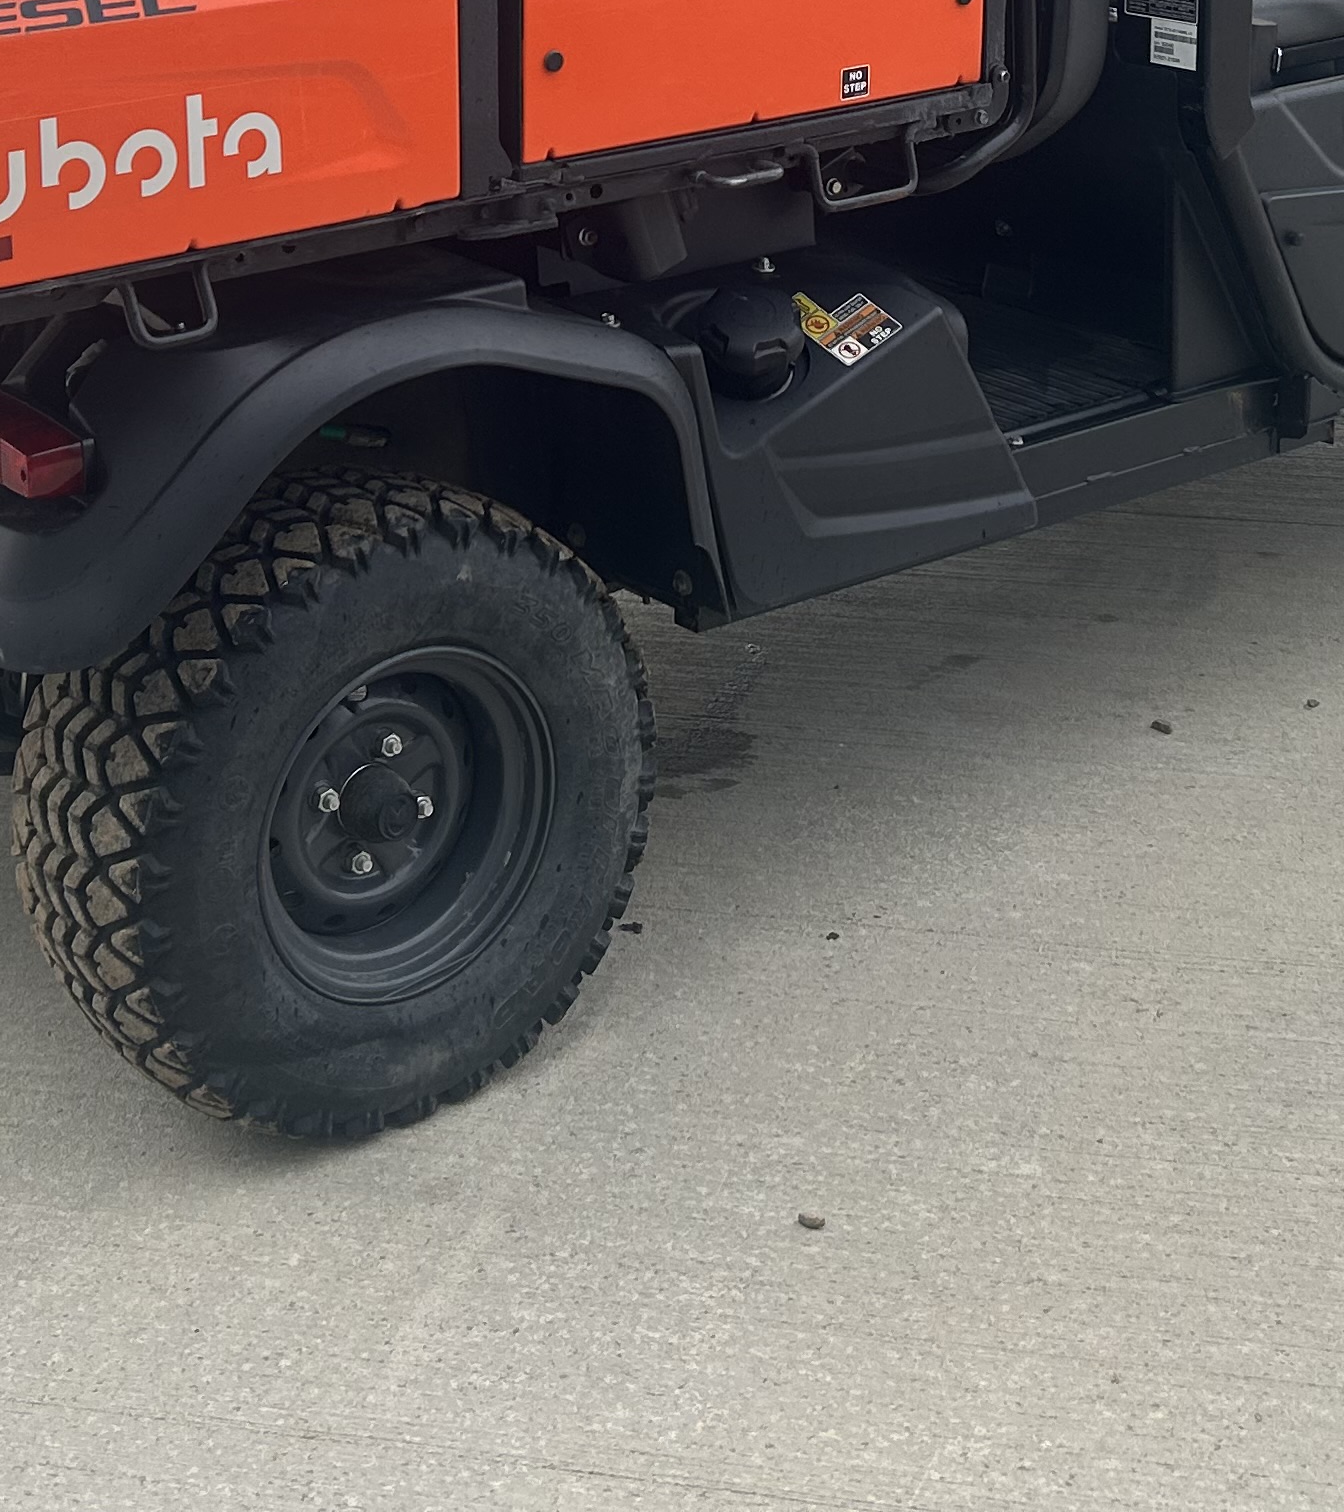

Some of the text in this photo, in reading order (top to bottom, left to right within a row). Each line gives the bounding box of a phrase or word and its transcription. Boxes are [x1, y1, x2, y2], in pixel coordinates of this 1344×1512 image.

[849, 70, 863, 81] NO
[843, 81, 867, 94] STEP
[869, 325, 883, 337] NO
[870, 327, 892, 344] STEP
